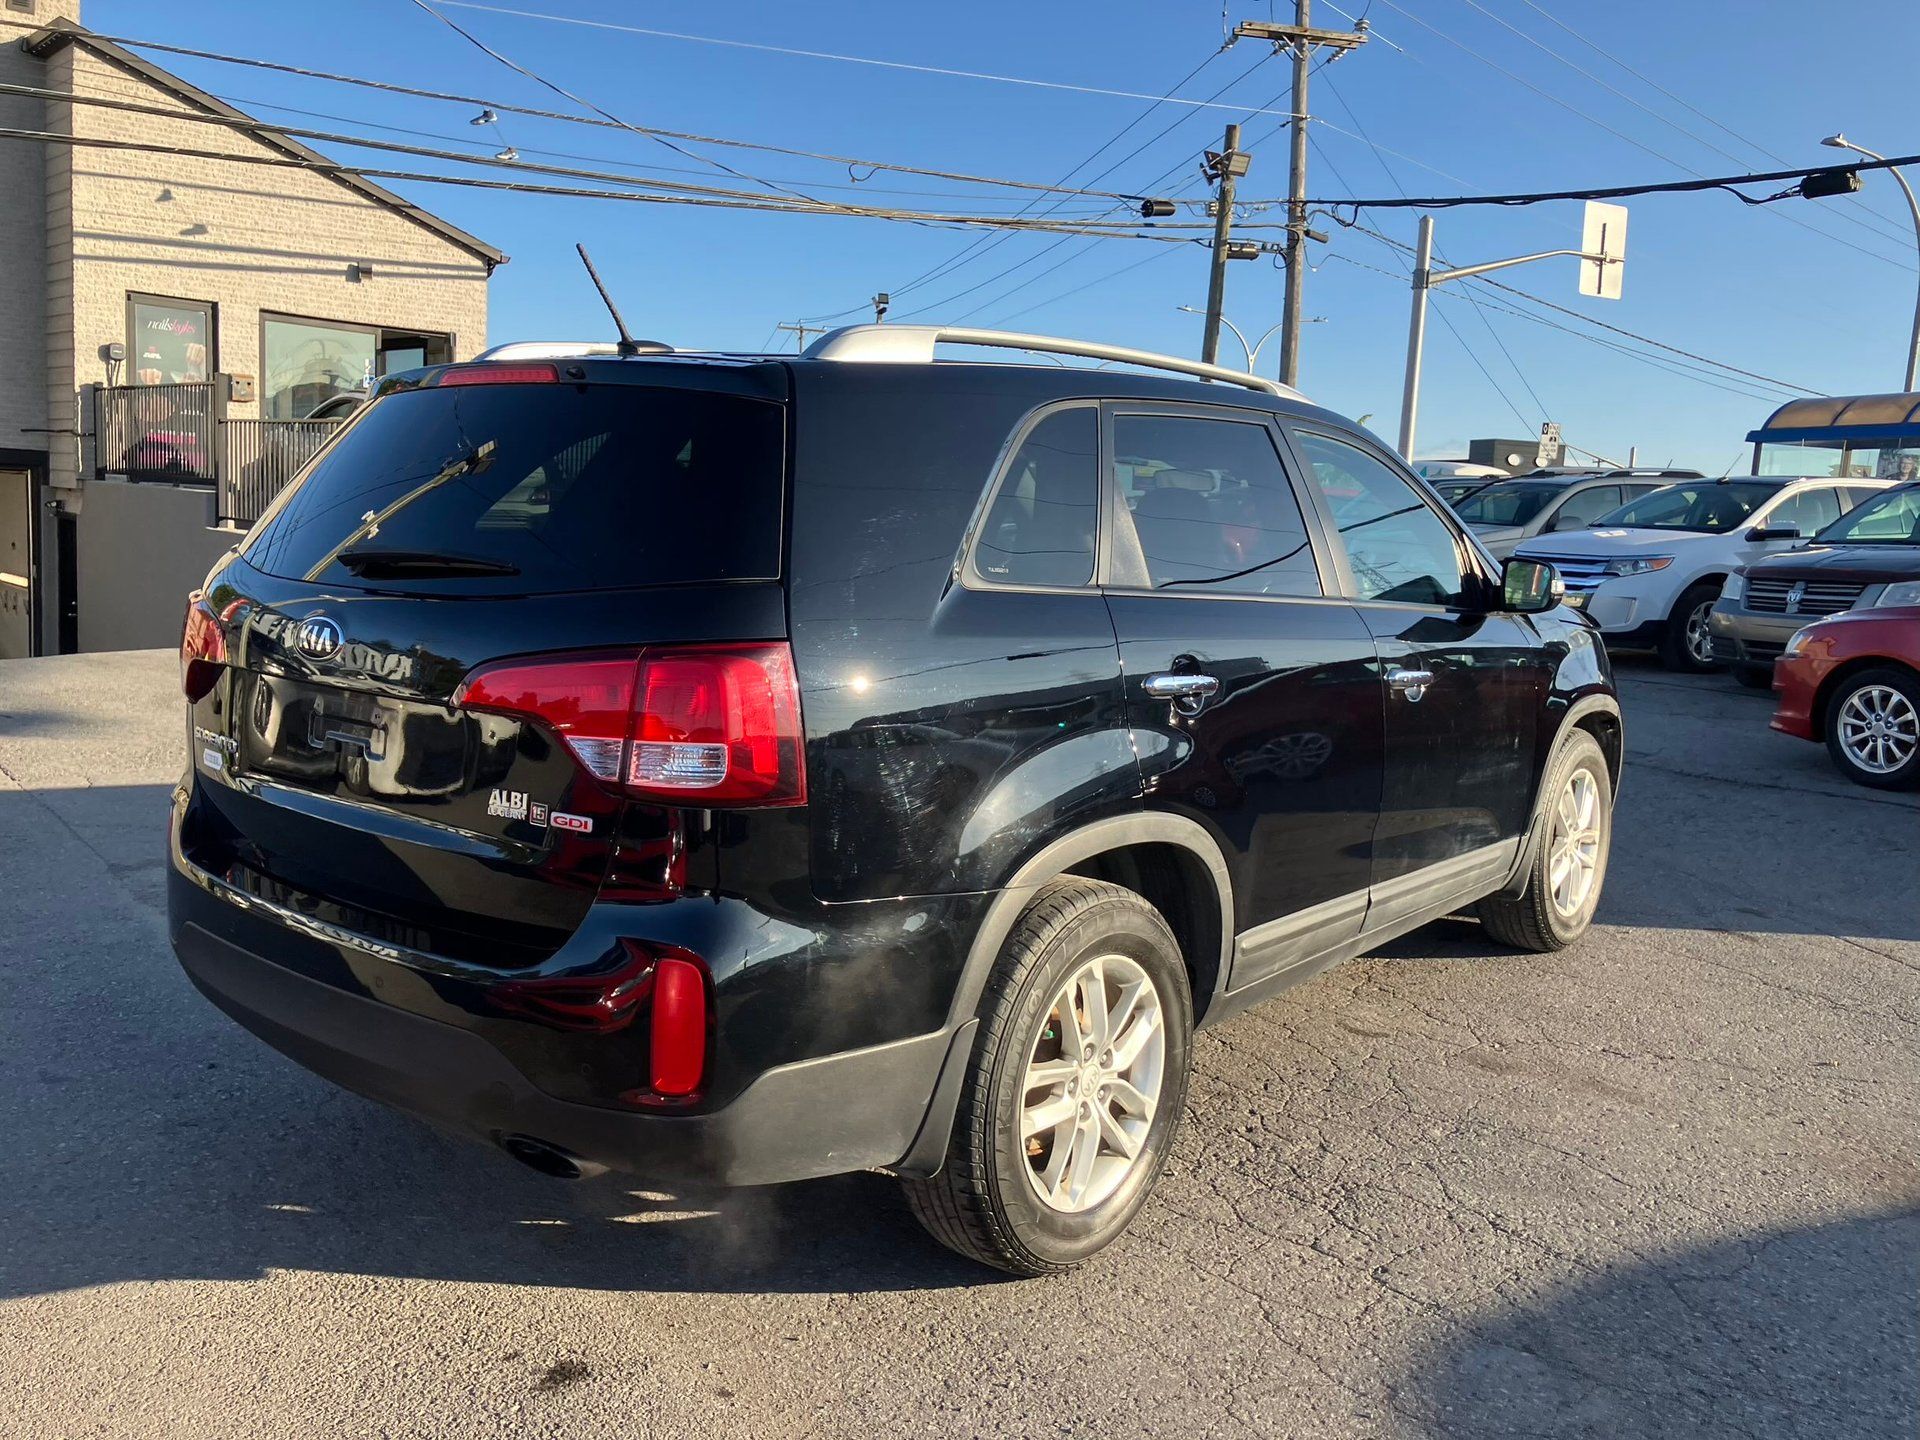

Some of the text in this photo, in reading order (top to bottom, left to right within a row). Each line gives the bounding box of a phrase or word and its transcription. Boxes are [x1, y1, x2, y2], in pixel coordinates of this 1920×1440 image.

[300, 624, 332, 652] KIA
[489, 788, 528, 810] ALBI
[532, 805, 545, 820] 15
[553, 815, 589, 830] GDI
